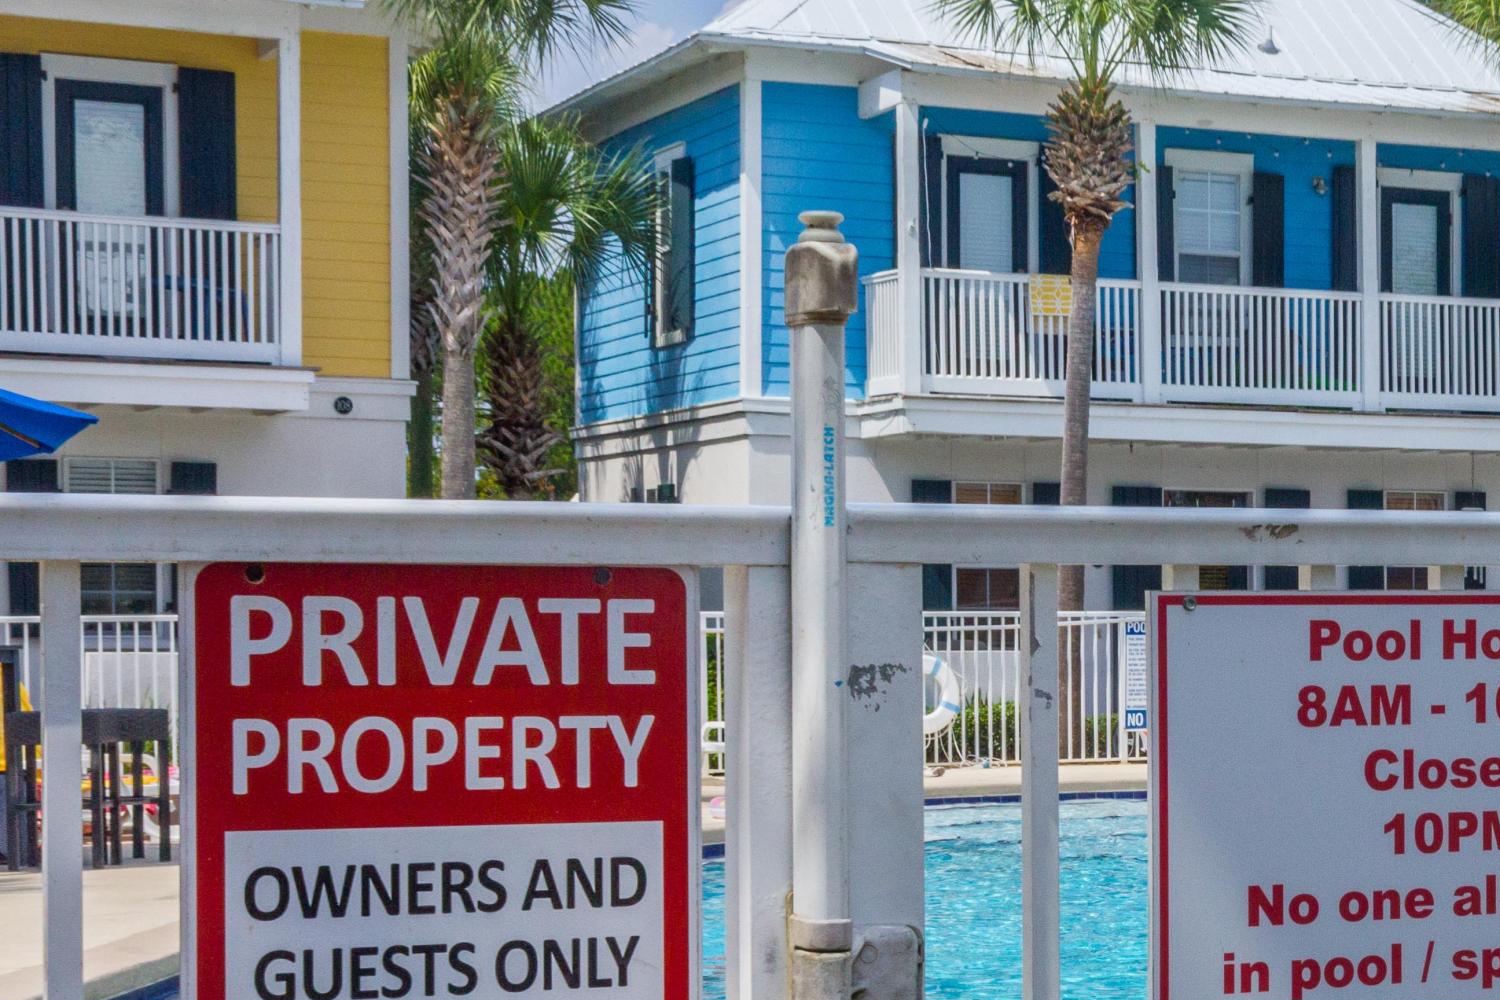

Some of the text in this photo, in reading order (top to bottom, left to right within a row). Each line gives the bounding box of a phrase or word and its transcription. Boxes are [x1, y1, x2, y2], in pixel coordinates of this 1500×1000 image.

[231, 595, 656, 686] PRIVATE
[1310, 619, 1421, 661] Pool
[1127, 713, 1144, 726] NO
[1297, 684, 1411, 728] 8AM
[1431, 705, 1445, 714] -
[233, 715, 655, 795] PROPERTY
[244, 857, 647, 921] OWNERS AND
[1248, 884, 1319, 927] No
[1339, 888, 1434, 921] one
[495, 936, 640, 992] ONLY
[1224, 952, 1269, 995] in
[1291, 944, 1401, 1000] pool
[1422, 941, 1435, 982] /
